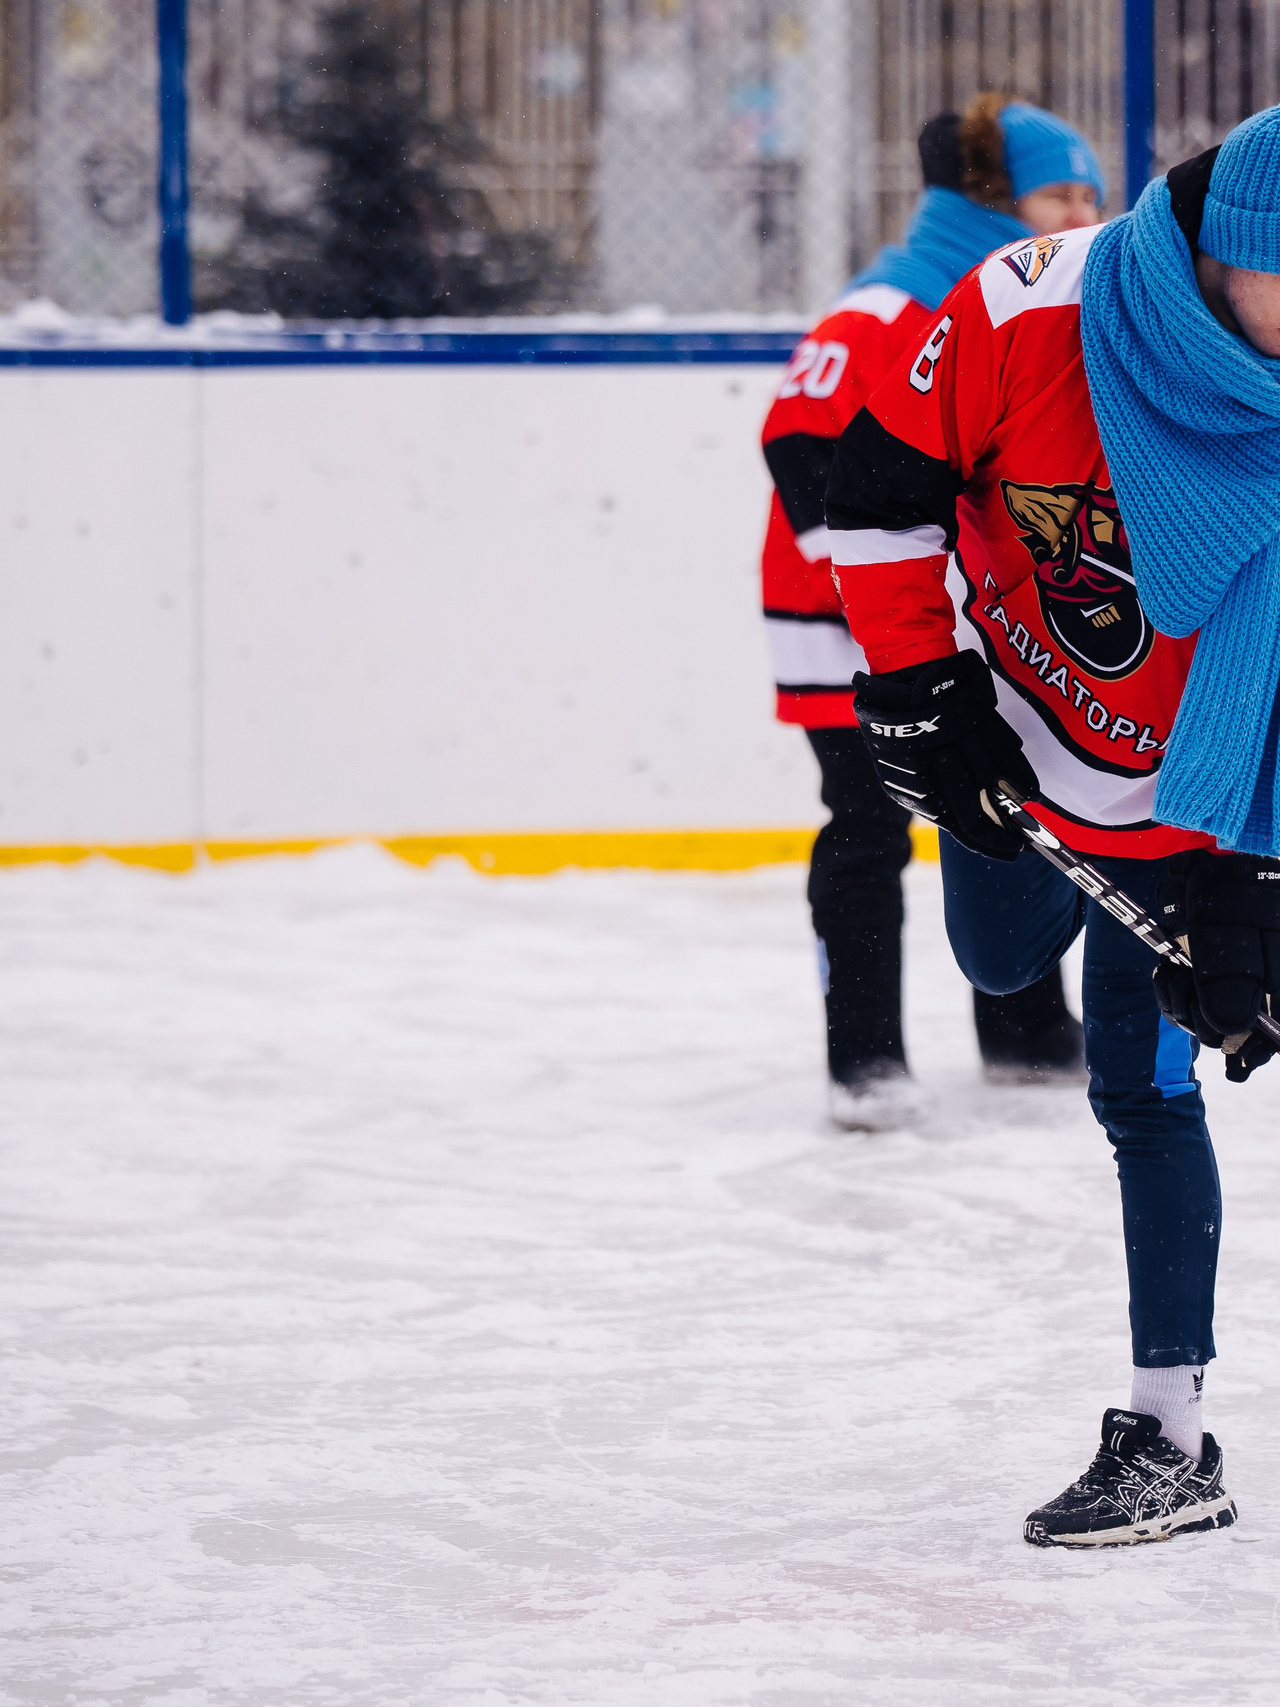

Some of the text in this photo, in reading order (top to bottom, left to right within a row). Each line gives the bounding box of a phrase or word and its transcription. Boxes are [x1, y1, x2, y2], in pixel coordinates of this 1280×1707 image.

[779, 339, 849, 399] 20
[909, 313, 953, 395] 8
[869, 714, 941, 737] STEX
